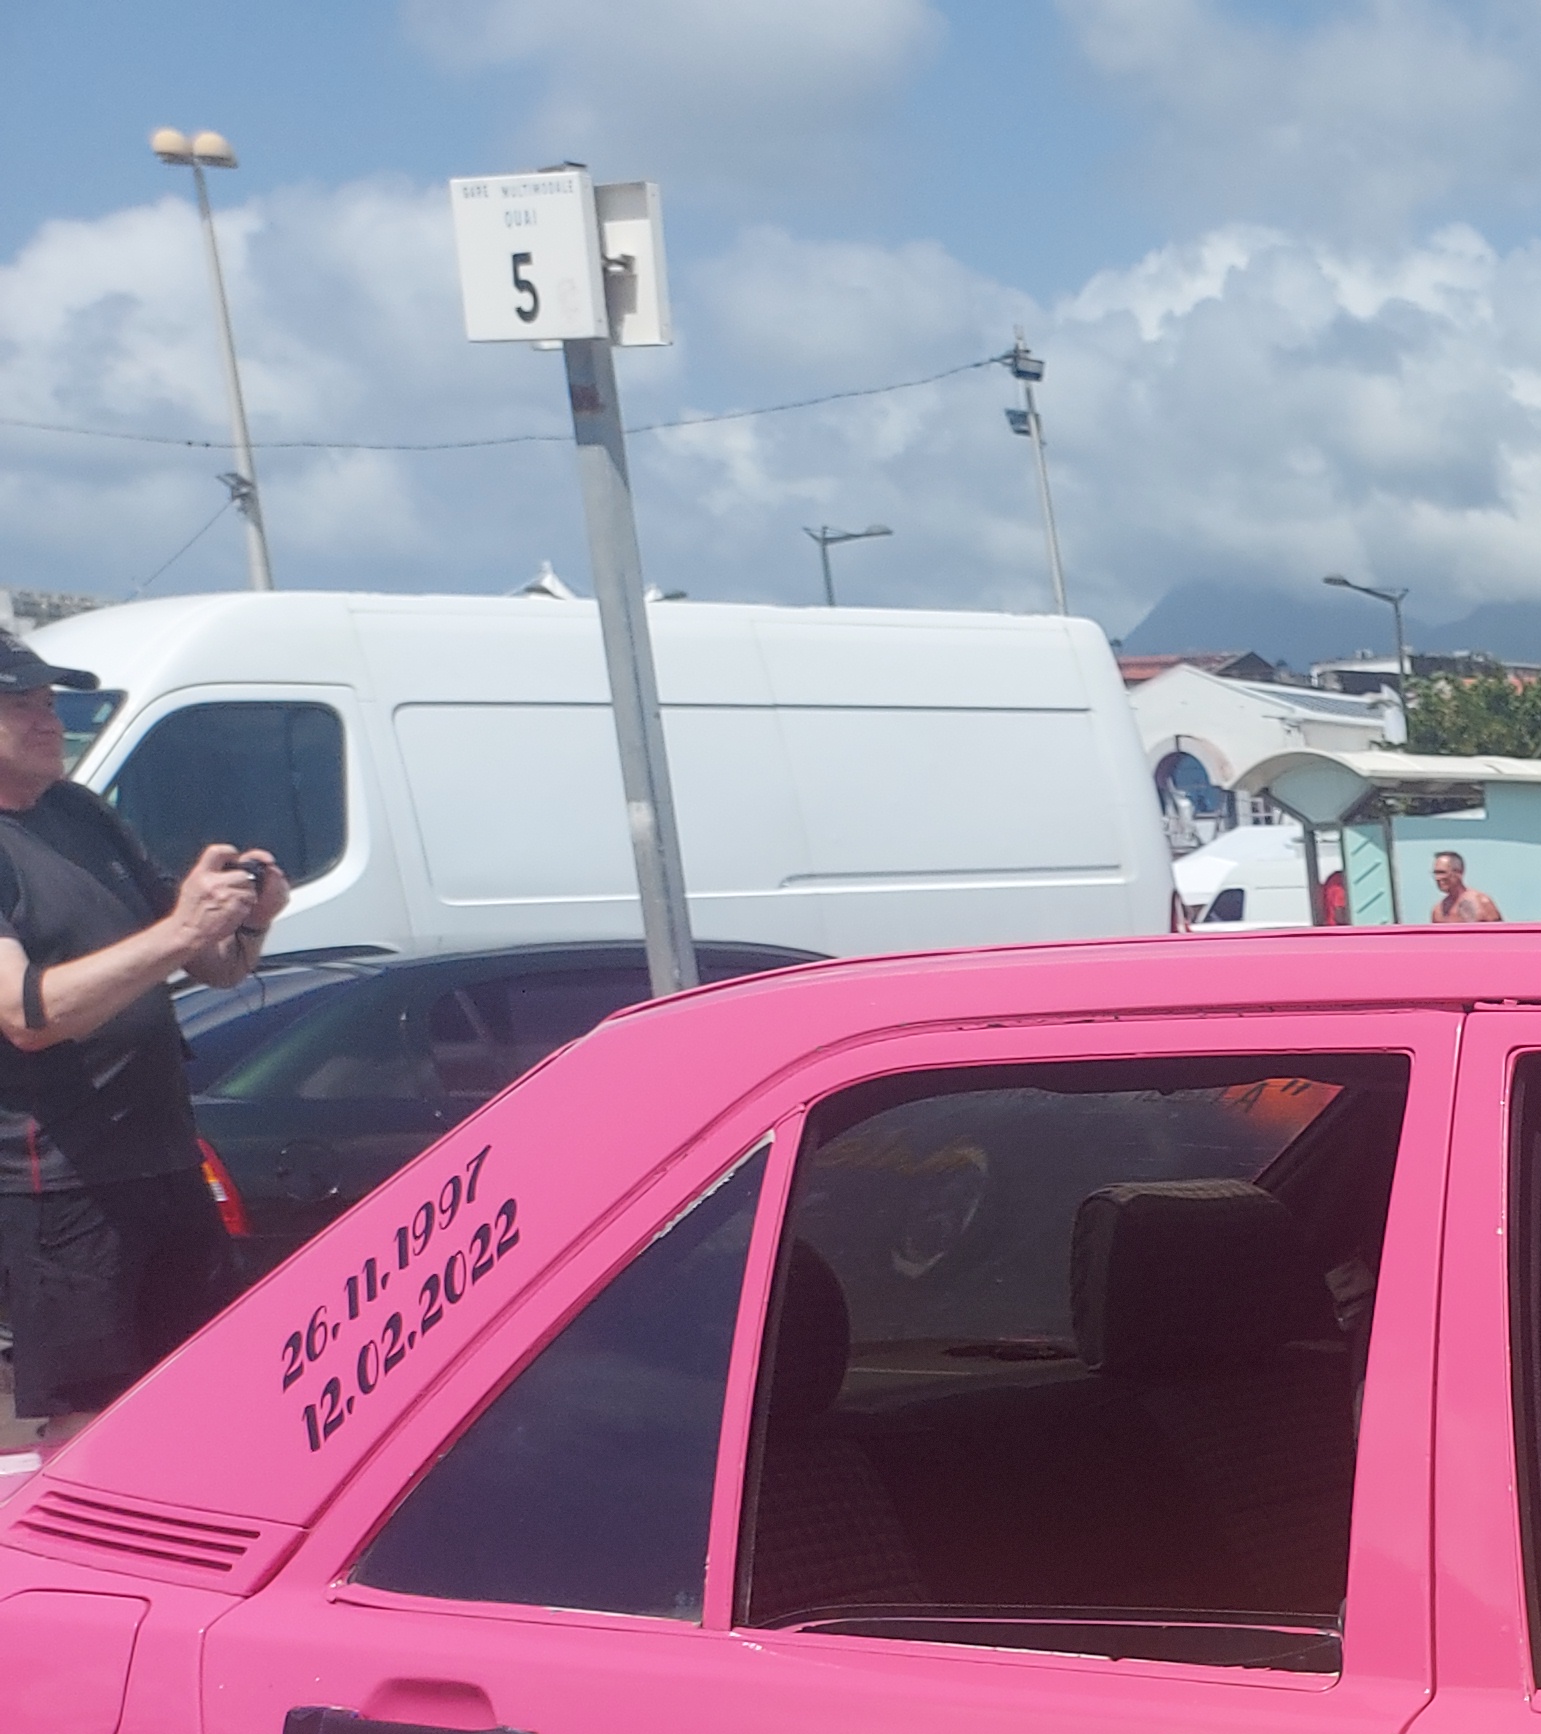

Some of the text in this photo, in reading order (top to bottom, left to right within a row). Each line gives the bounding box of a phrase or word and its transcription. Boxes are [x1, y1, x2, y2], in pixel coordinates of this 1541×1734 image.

[504, 209, 537, 228] QUAI
[512, 252, 540, 324] 5
[281, 1144, 492, 1393] 26.11.1997
[301, 1198, 520, 1453] 12.02.2022
